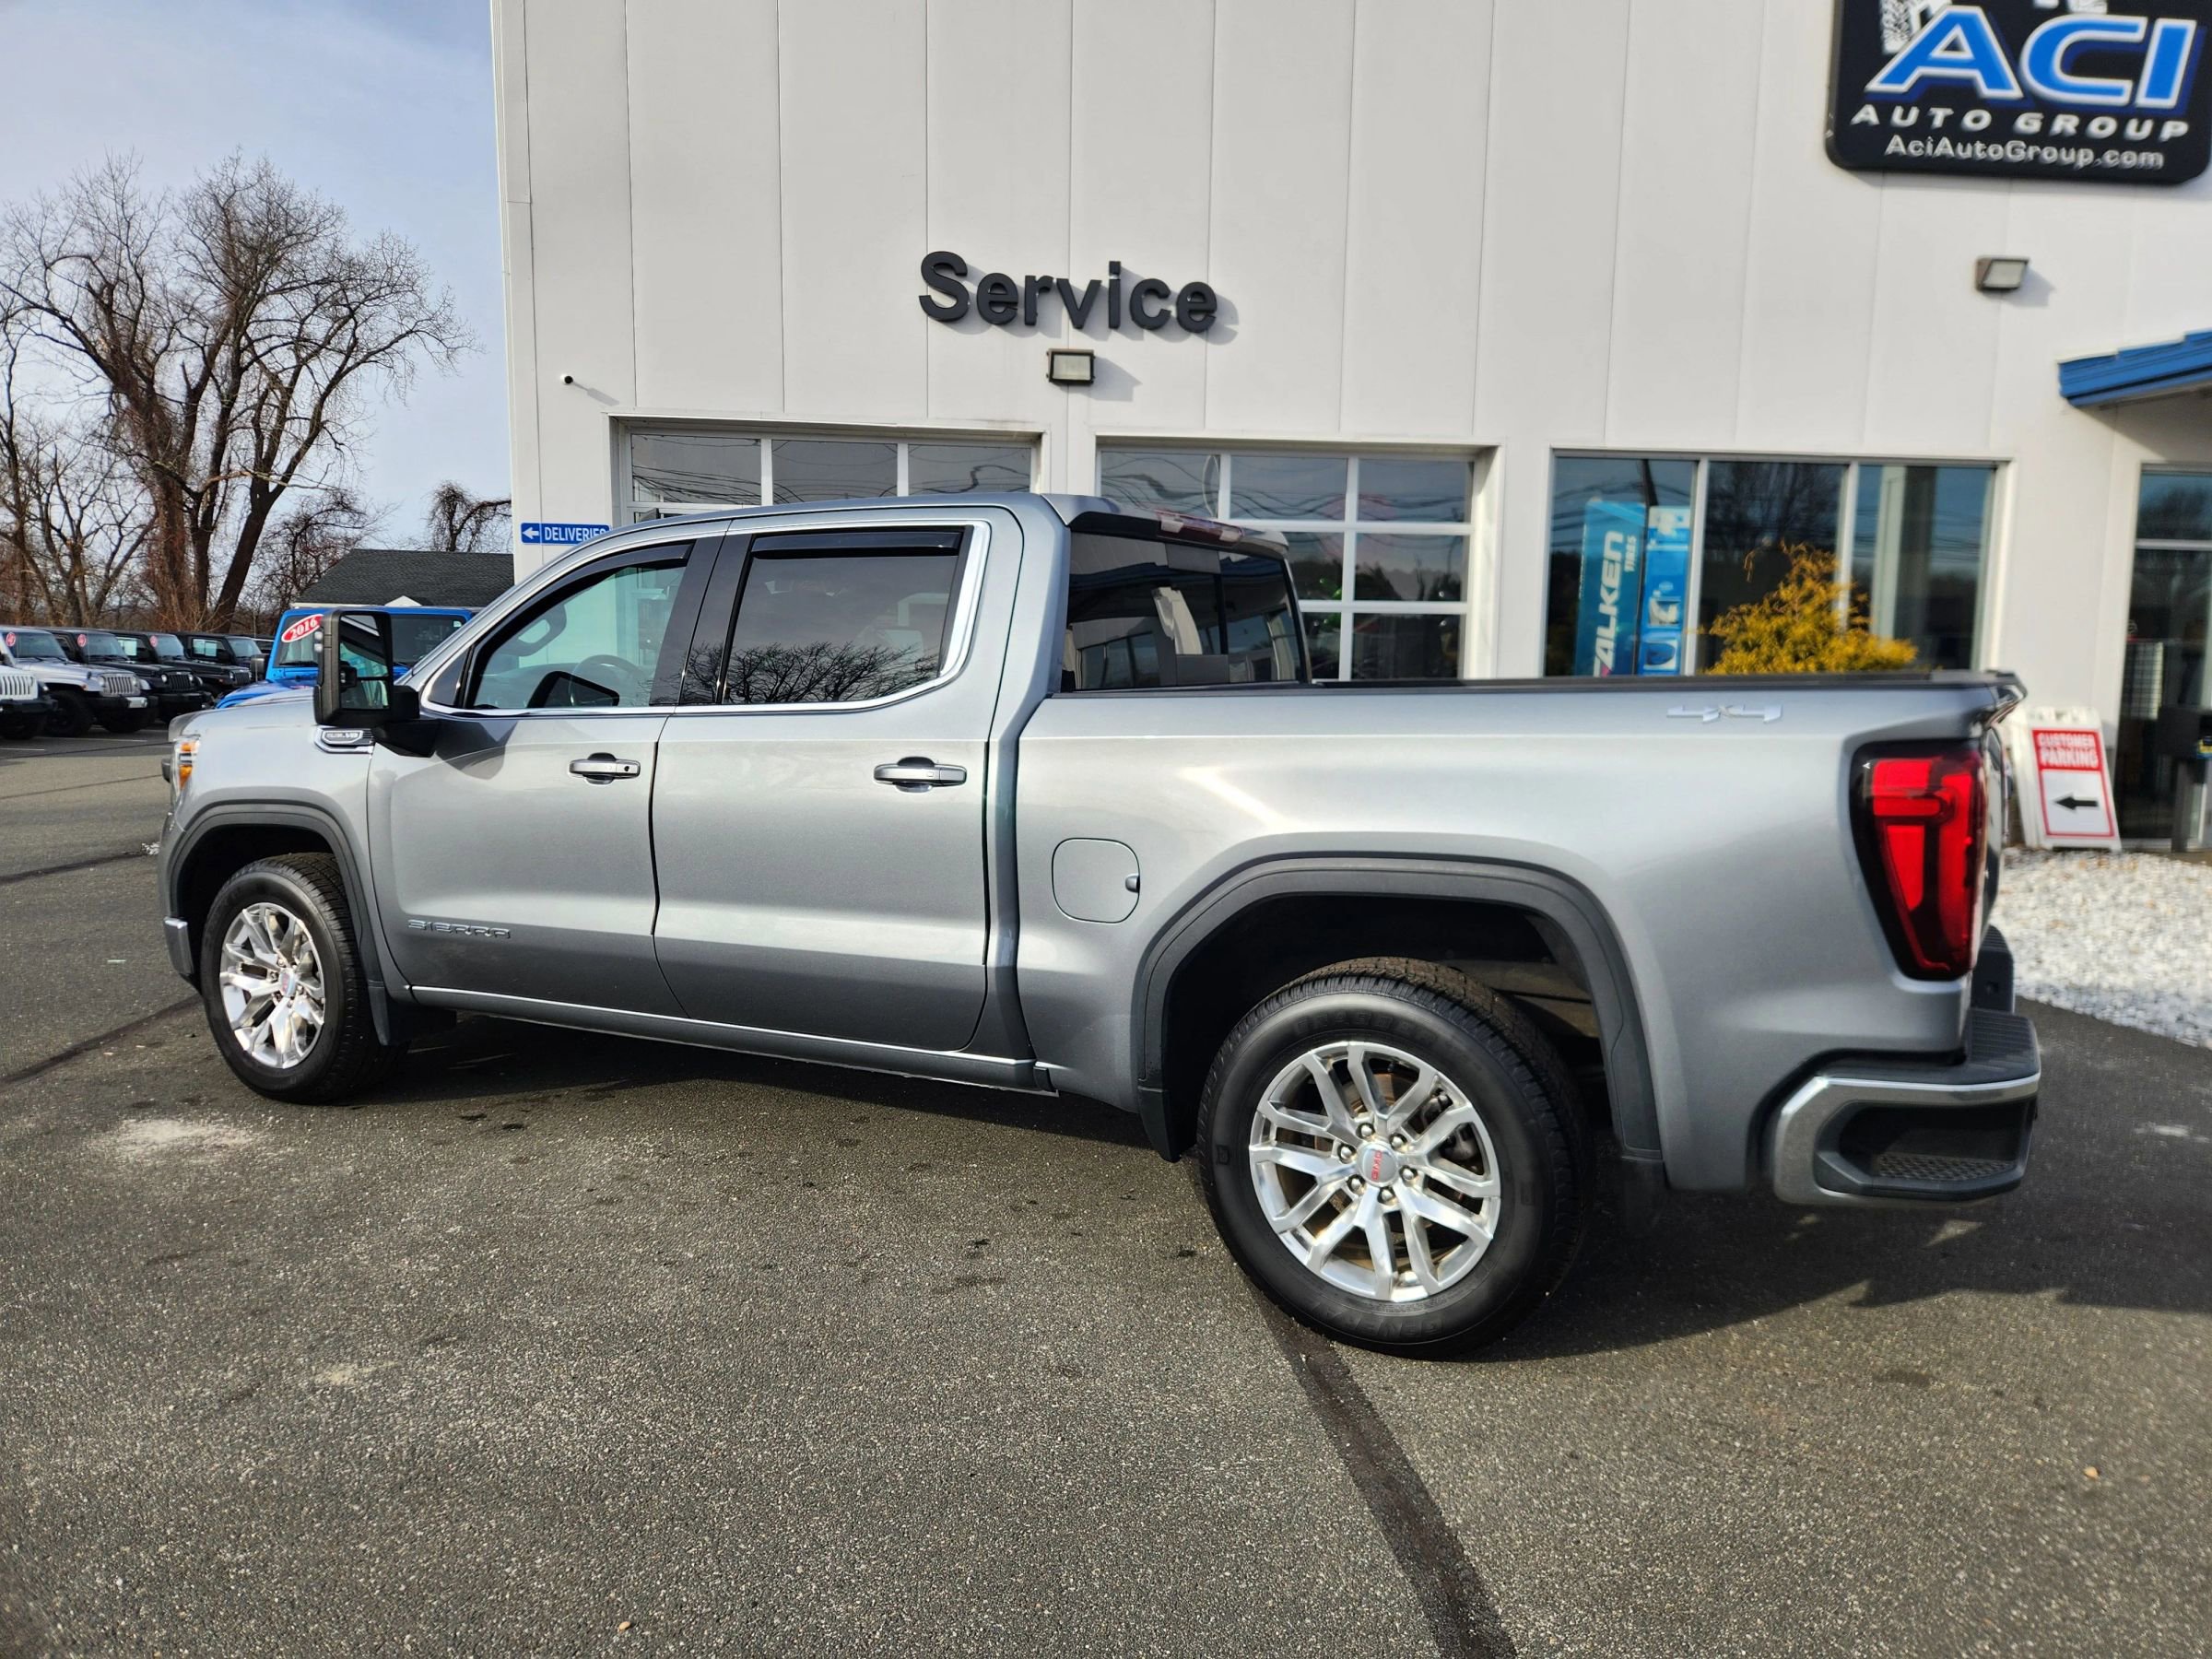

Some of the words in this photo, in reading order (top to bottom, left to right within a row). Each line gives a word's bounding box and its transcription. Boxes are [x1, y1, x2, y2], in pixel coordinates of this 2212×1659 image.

[1865, 5, 2197, 109] ACI
[1851, 103, 1992, 132] AUTO
[2013, 112, 2190, 142] GROUP
[1884, 134, 2165, 170] AciAutoGroup.com
[918, 250, 1218, 334] Service
[290, 617, 318, 641] 2016
[2041, 747, 2099, 769] PARKING
[407, 919, 512, 939] SIERRA
